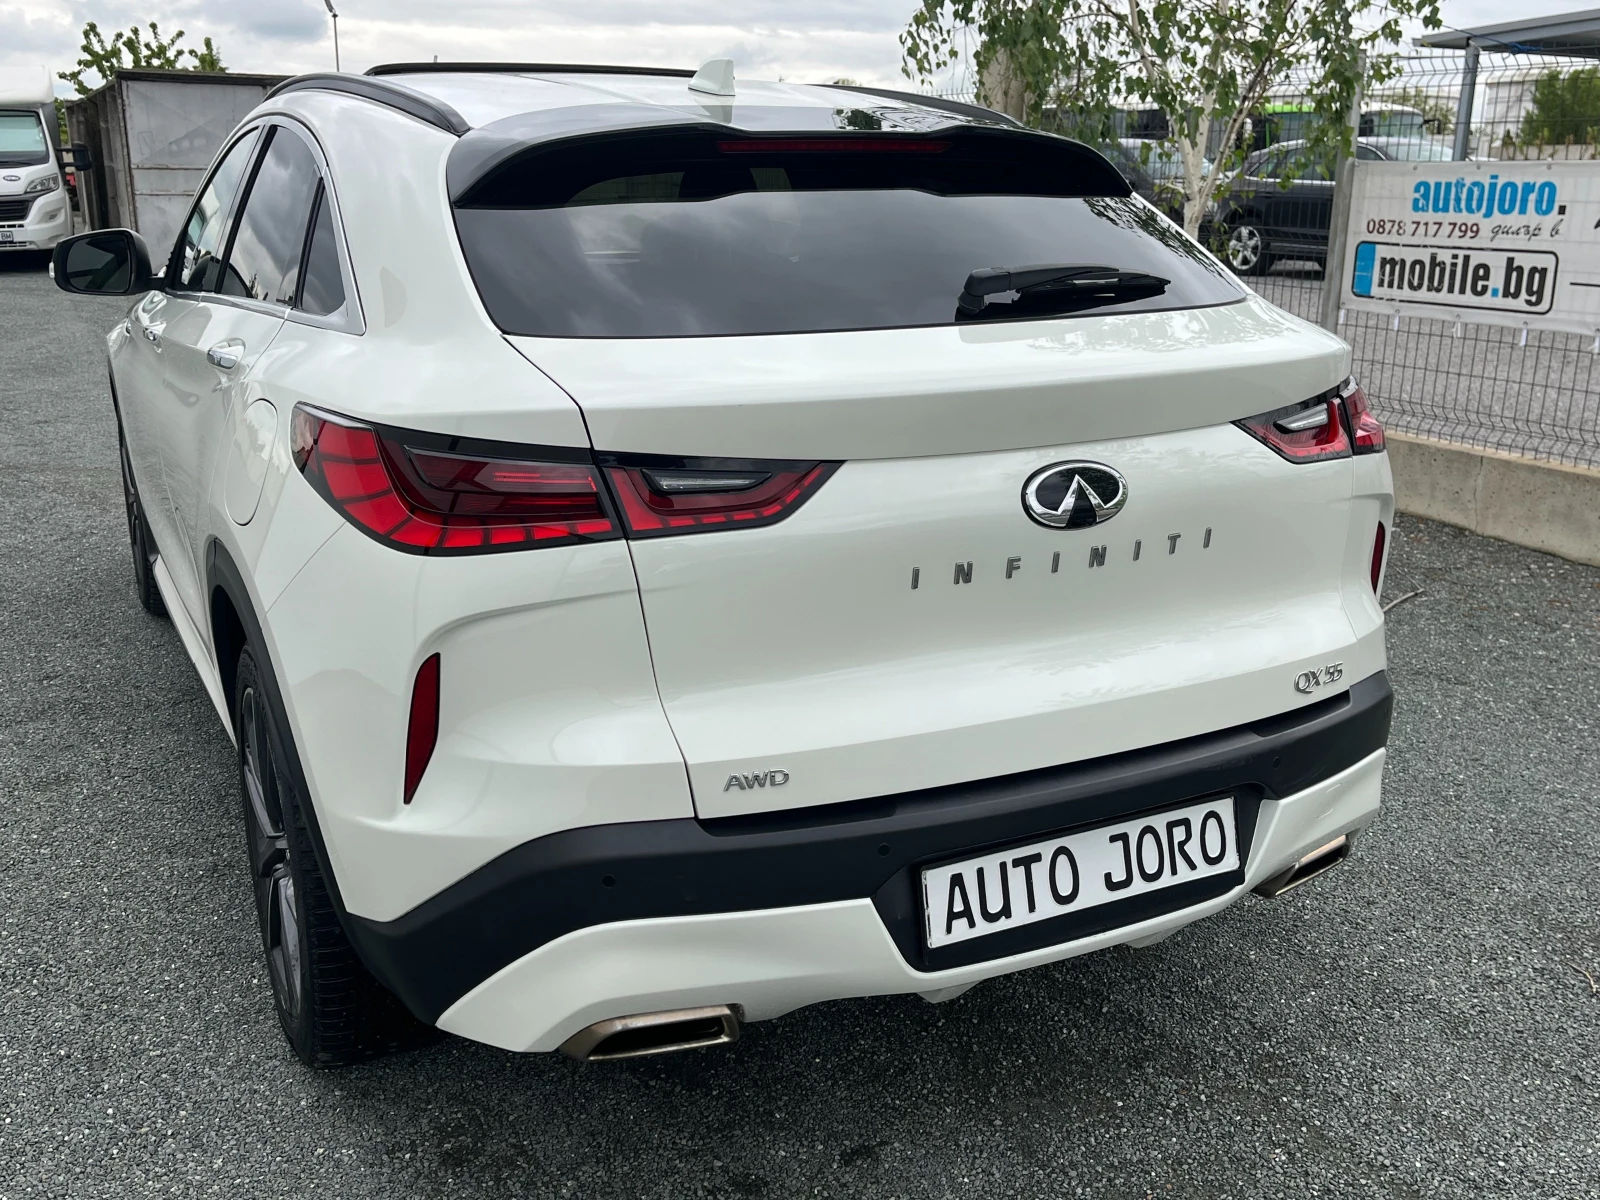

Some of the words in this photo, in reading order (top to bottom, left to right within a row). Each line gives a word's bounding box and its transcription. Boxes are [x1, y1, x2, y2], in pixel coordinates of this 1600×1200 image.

[1366, 219, 1406, 236] 0878
[1411, 221, 1442, 238] 717
[1447, 222, 1480, 239] 799
[1377, 253, 1548, 306] mobile.bg
[911, 527, 1212, 590] INFINITI
[723, 768, 790, 792] AWD
[945, 845, 1080, 935] AUTO
[1104, 809, 1227, 892] JORO
